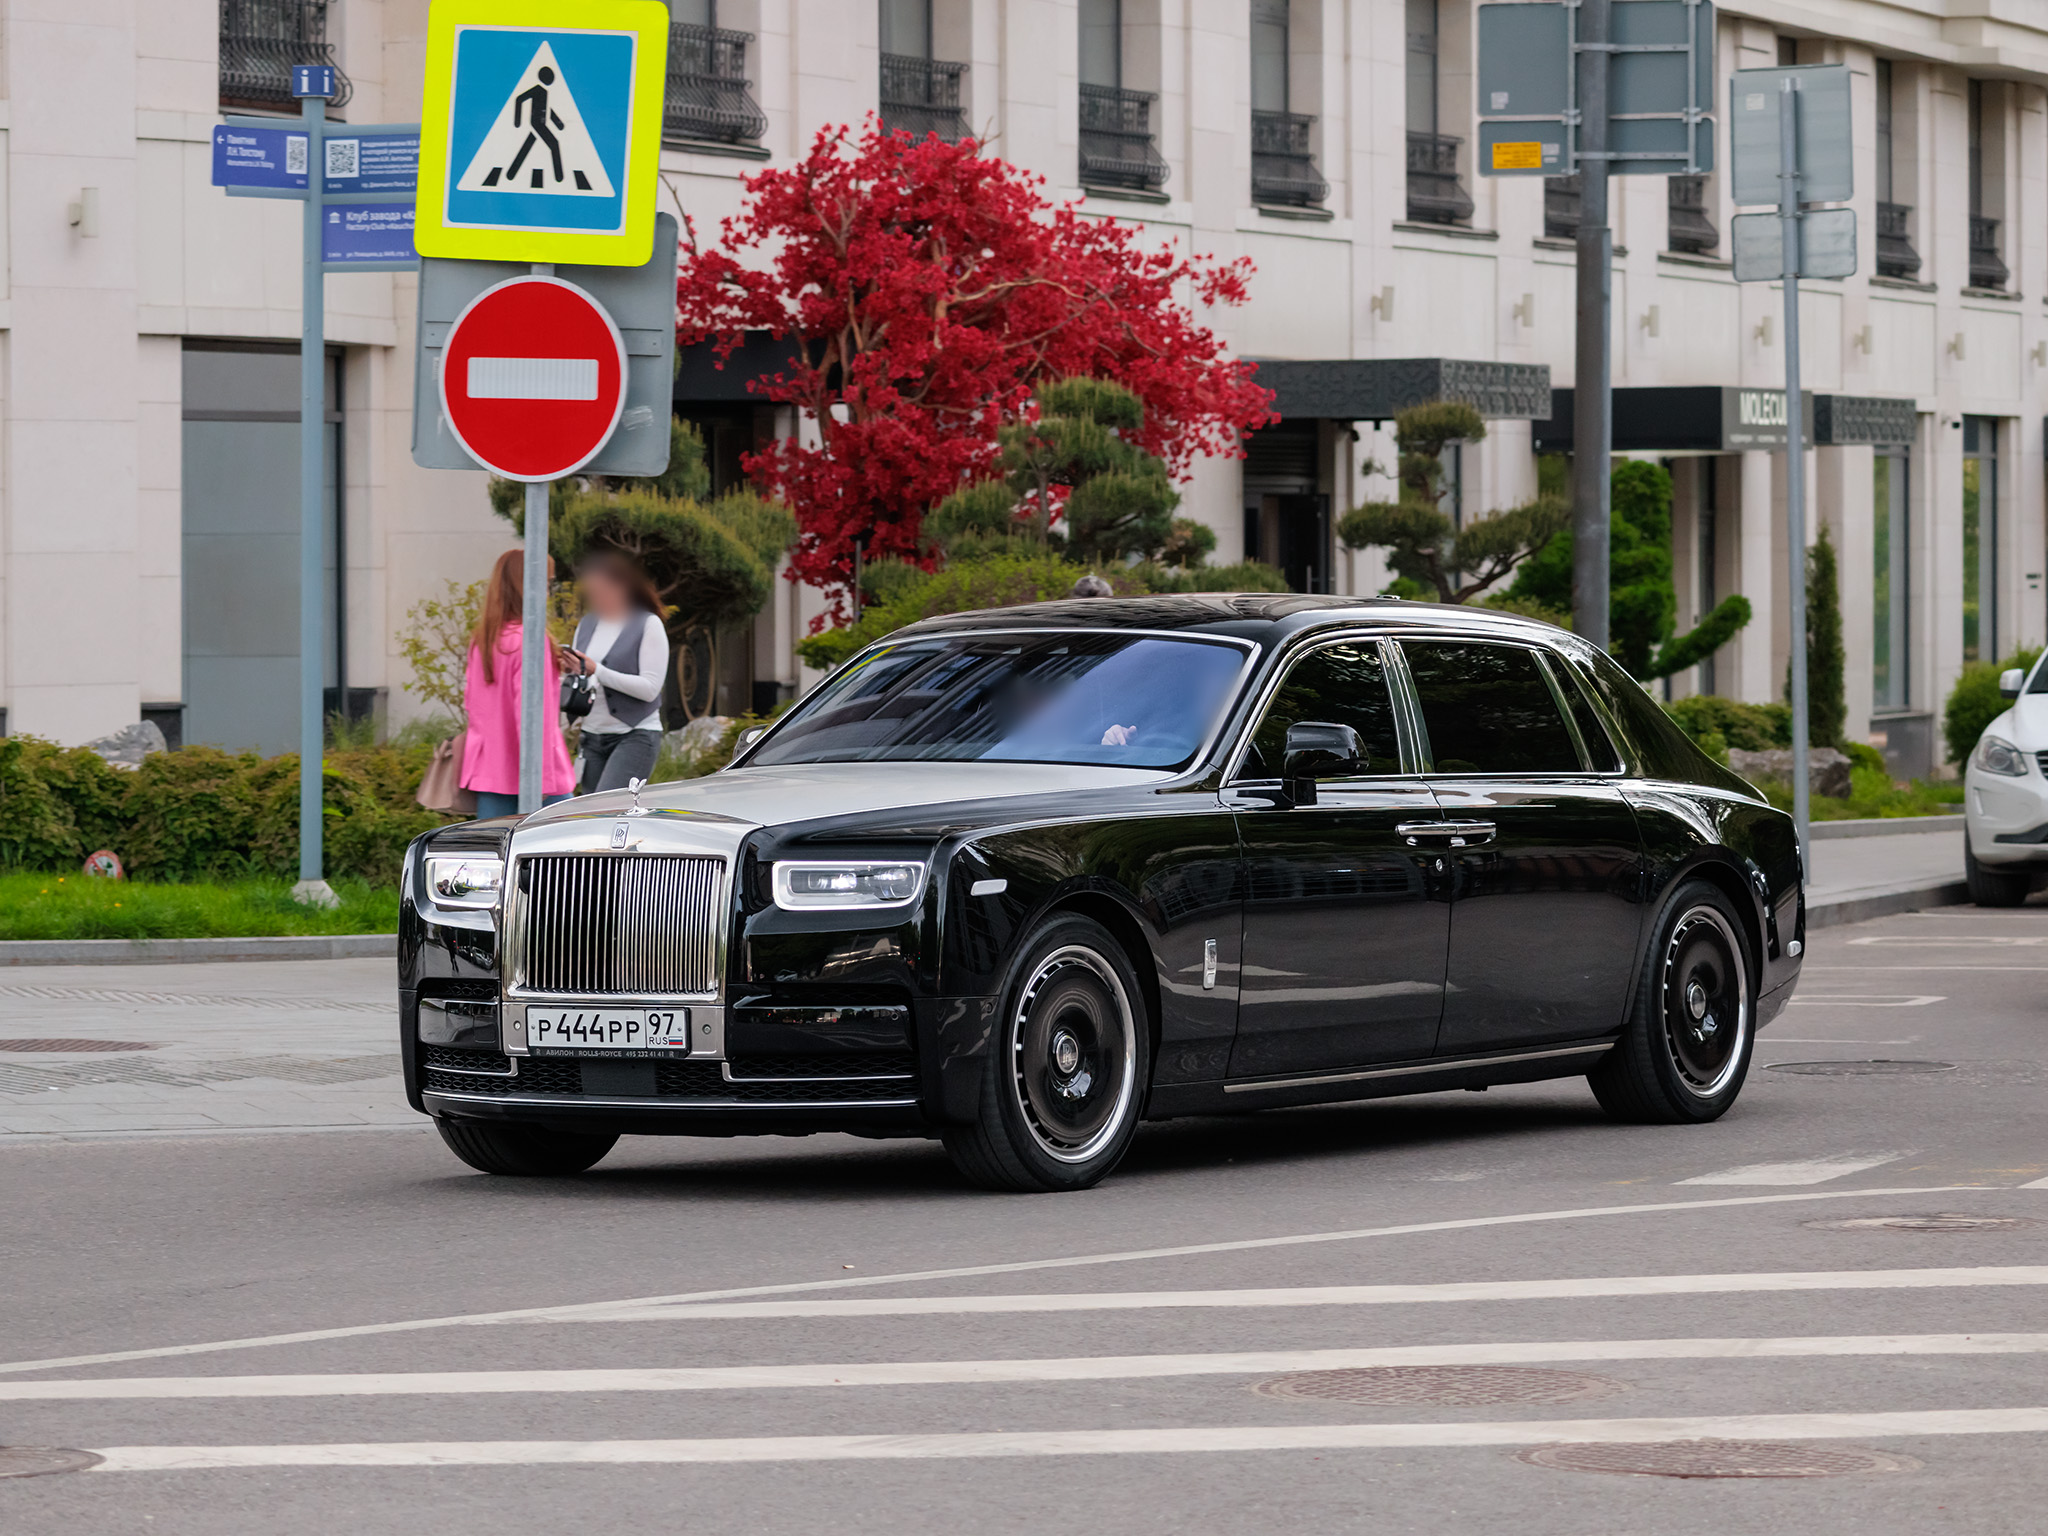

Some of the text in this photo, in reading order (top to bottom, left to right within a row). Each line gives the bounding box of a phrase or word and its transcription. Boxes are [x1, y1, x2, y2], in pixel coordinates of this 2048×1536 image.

[345, 210, 369, 223] Клуб
[648, 1013, 675, 1036] 97
[649, 1036, 668, 1045] RUS
[578, 1050, 622, 1058] ROLLS-ROYCE
